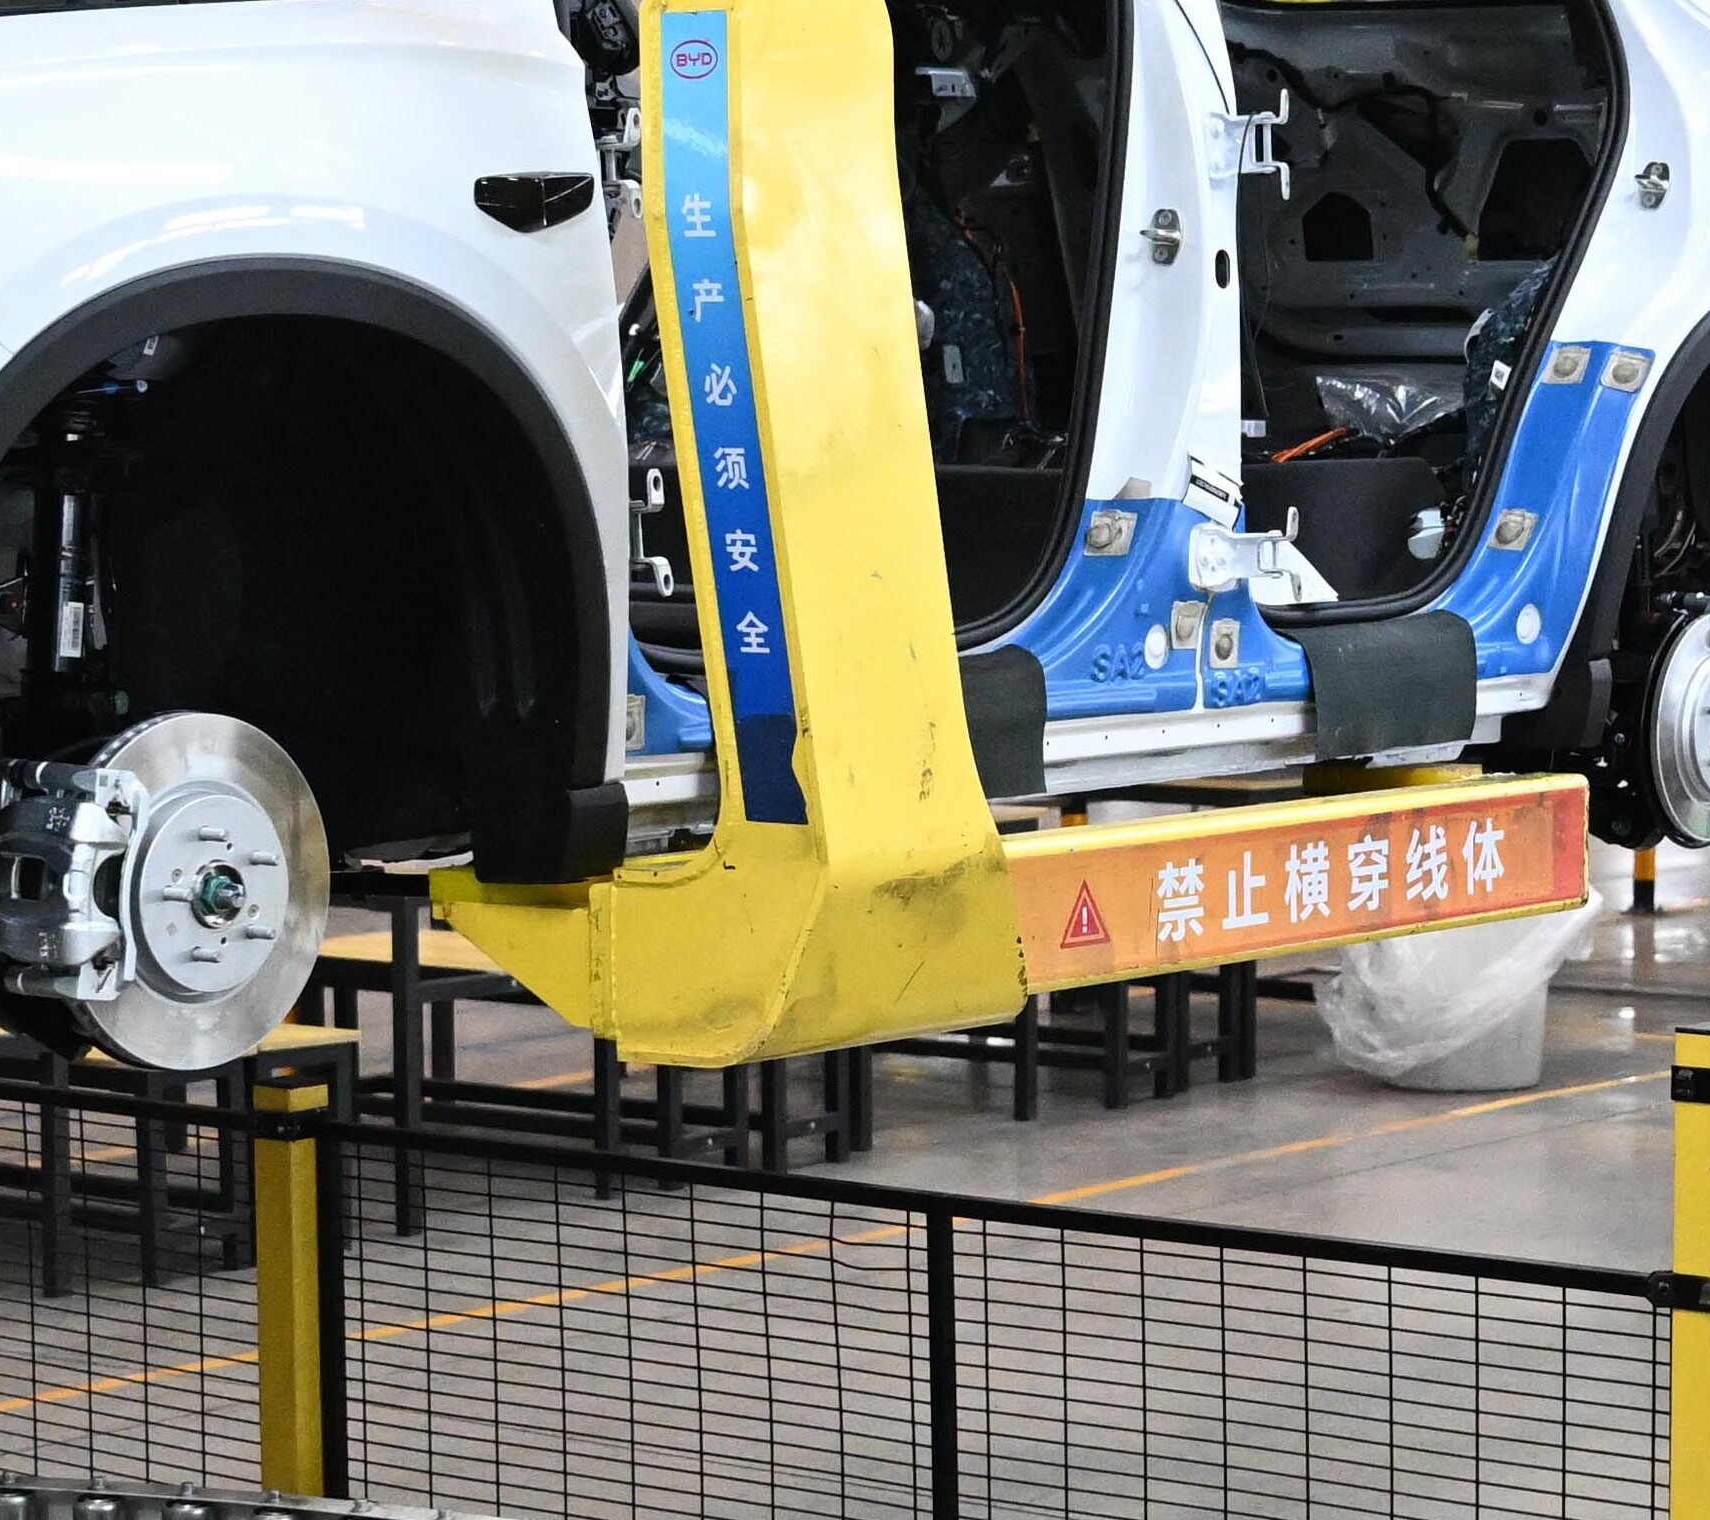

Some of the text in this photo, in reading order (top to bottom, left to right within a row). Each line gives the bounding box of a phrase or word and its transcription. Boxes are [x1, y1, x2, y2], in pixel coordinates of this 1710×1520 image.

[681, 192, 771, 656] 生产必须安全
[1156, 818, 1506, 943] 禁止横穿线体
